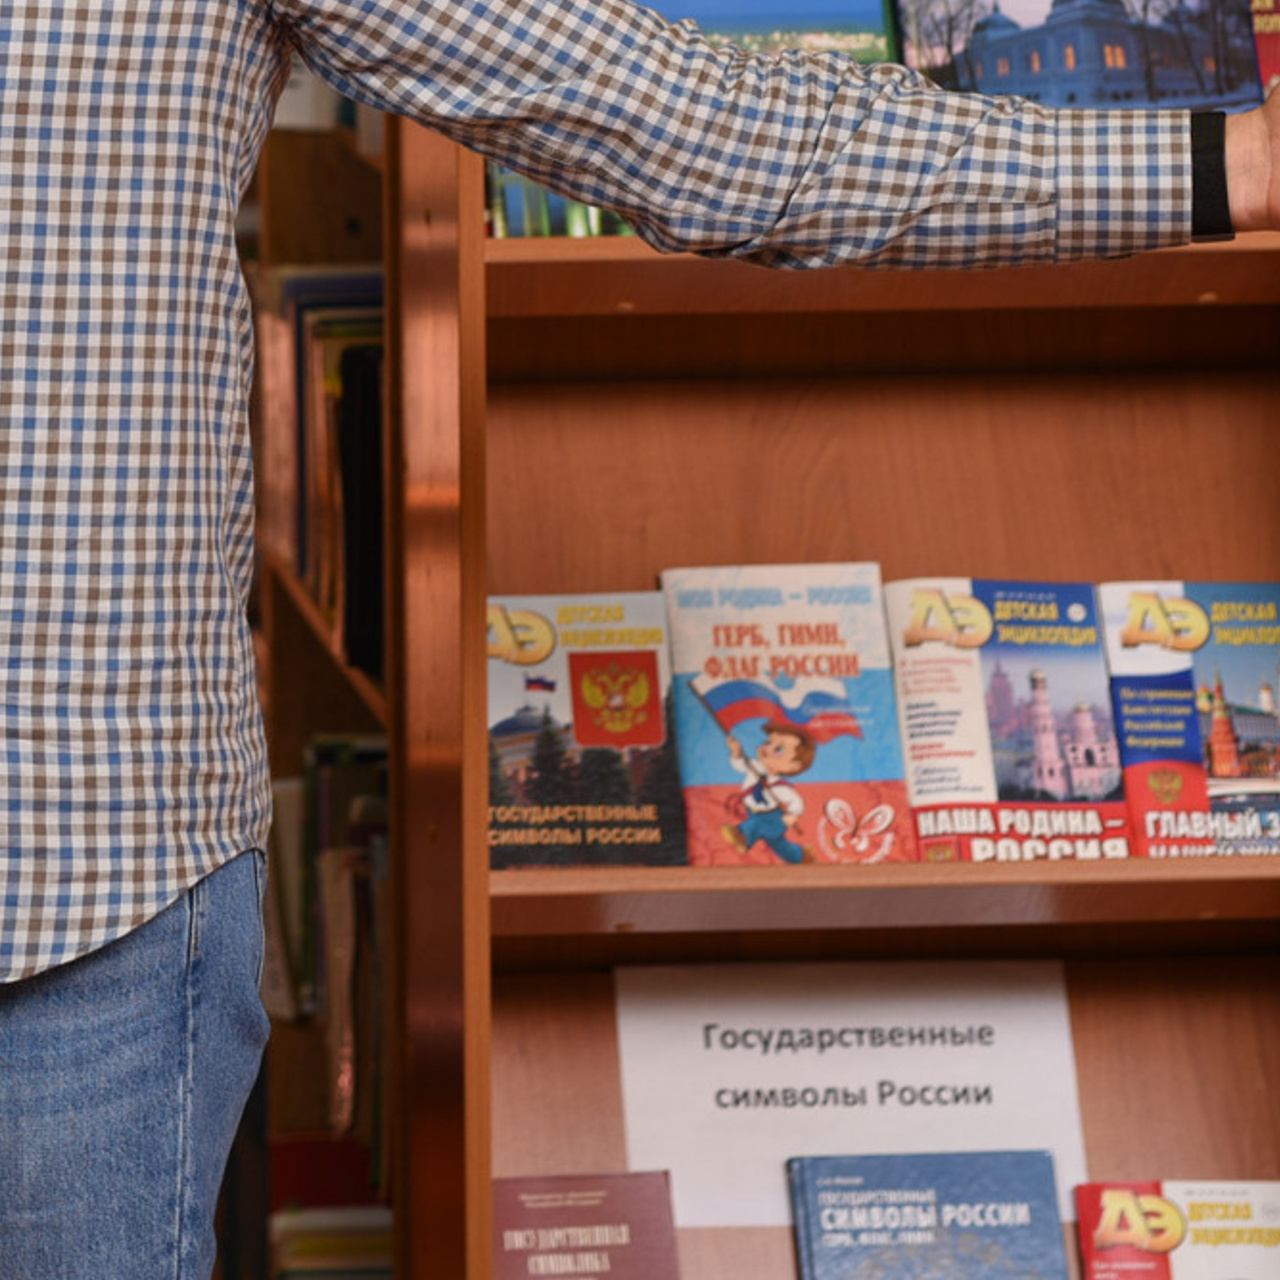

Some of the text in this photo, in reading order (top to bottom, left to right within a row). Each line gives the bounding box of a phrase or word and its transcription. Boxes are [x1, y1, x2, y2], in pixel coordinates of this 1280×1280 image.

[770, 653, 861, 678] РОССИИ
[586, 827, 662, 846] РОССИИ
[917, 808, 995, 837] НАША
[998, 808, 1103, 837] РОДИНА
[1145, 806, 1263, 839] ГЛАВНЫЙ
[702, 1022, 995, 1055] Государственные
[715, 1080, 994, 1110] символы России
[941, 1203, 1031, 1227] РОССИИ
